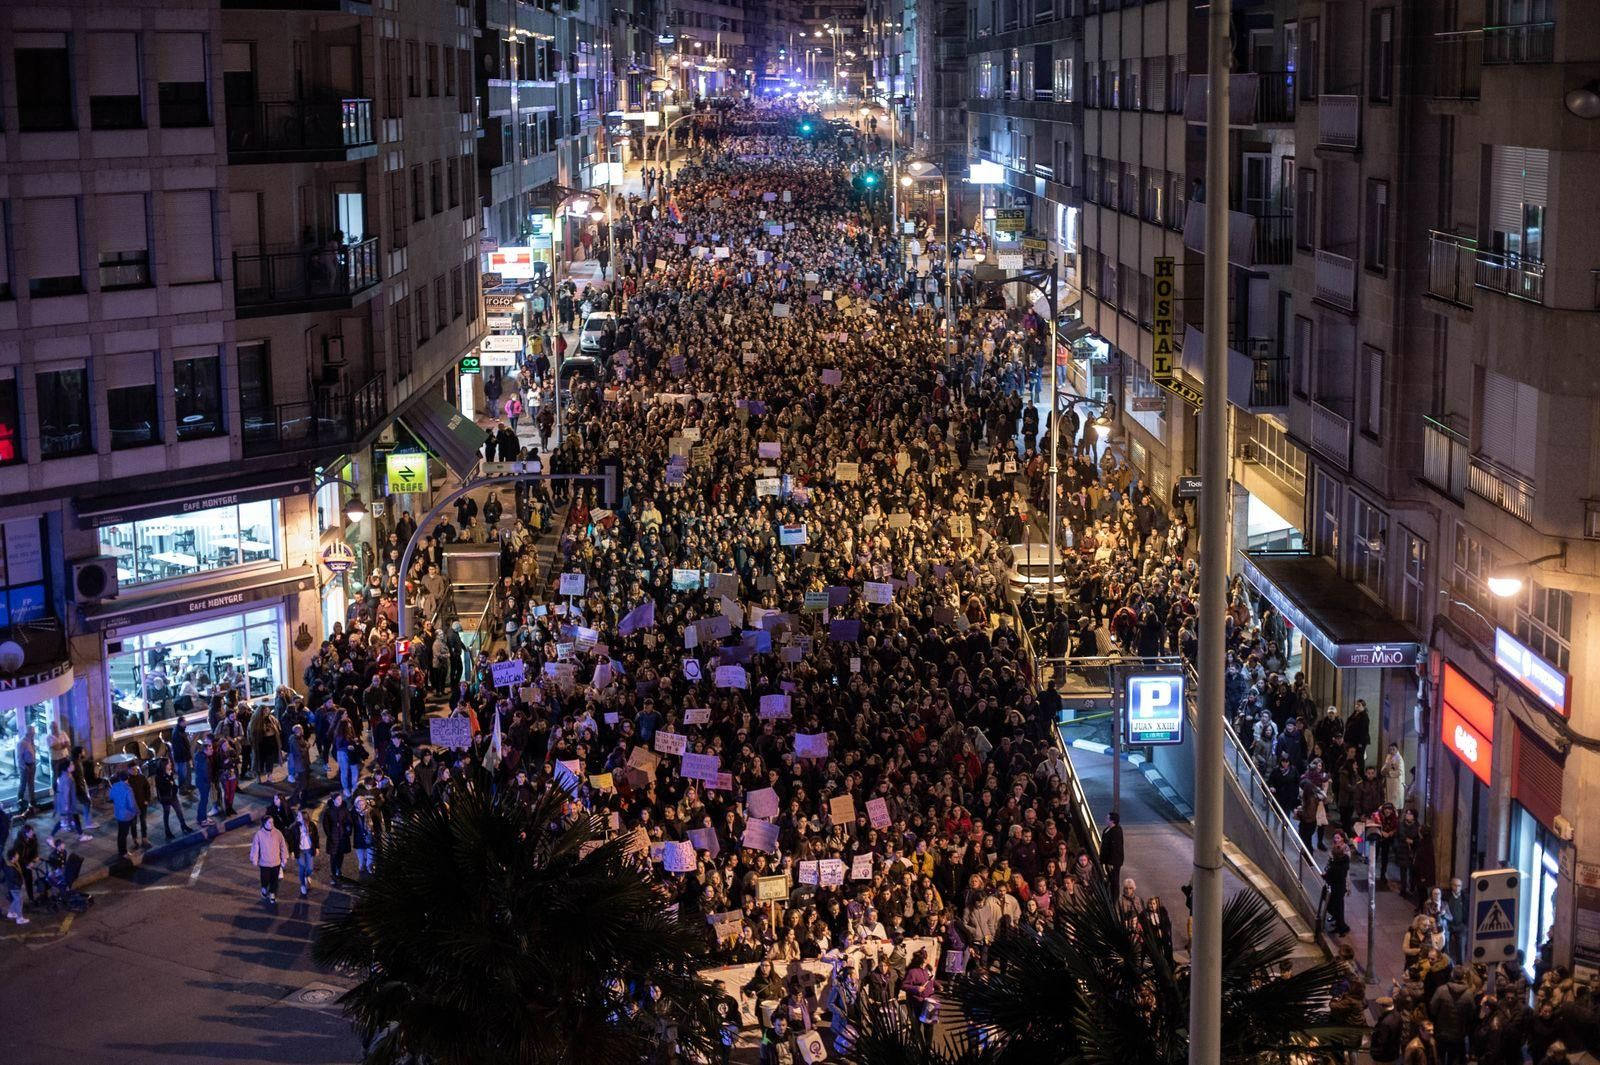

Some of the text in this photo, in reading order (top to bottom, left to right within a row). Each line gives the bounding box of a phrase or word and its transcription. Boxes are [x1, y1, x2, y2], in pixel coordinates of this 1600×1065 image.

[1155, 261, 1173, 373] HOSTAL
[202, 494, 238, 509] MONTGRE
[208, 593, 243, 608] MONTGRE
[1351, 654, 1370, 664] HOTEL
[1140, 682, 1171, 718] P
[431, 718, 468, 728] SOMOS
[1134, 722, 1175, 731] JUAN XXIII
